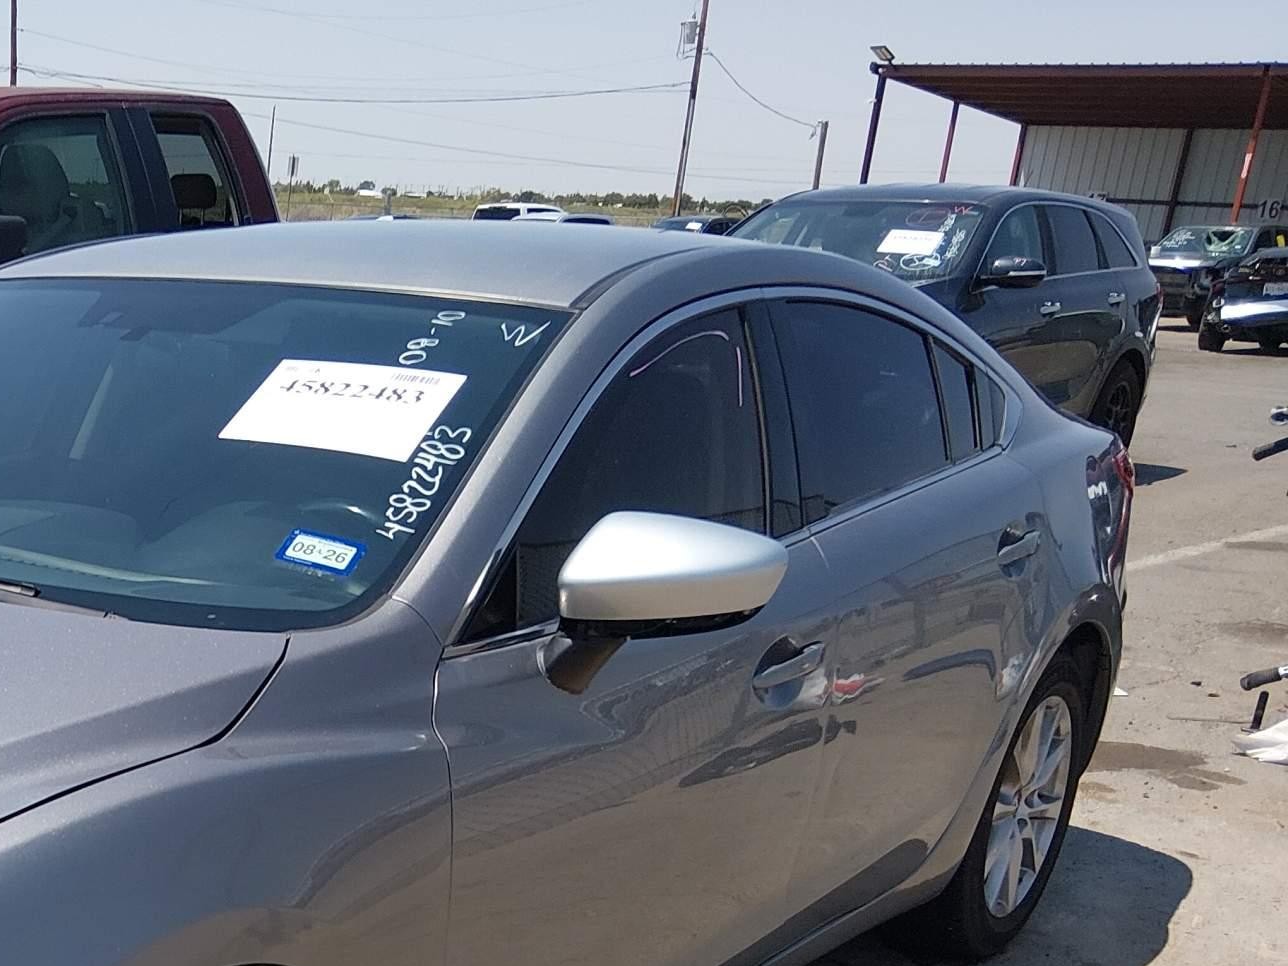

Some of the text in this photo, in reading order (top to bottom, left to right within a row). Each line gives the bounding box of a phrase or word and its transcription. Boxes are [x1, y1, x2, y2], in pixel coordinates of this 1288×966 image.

[1259, 200, 1281, 218] 16
[280, 379, 425, 404] 45822483
[375, 425, 472, 540] 45822483
